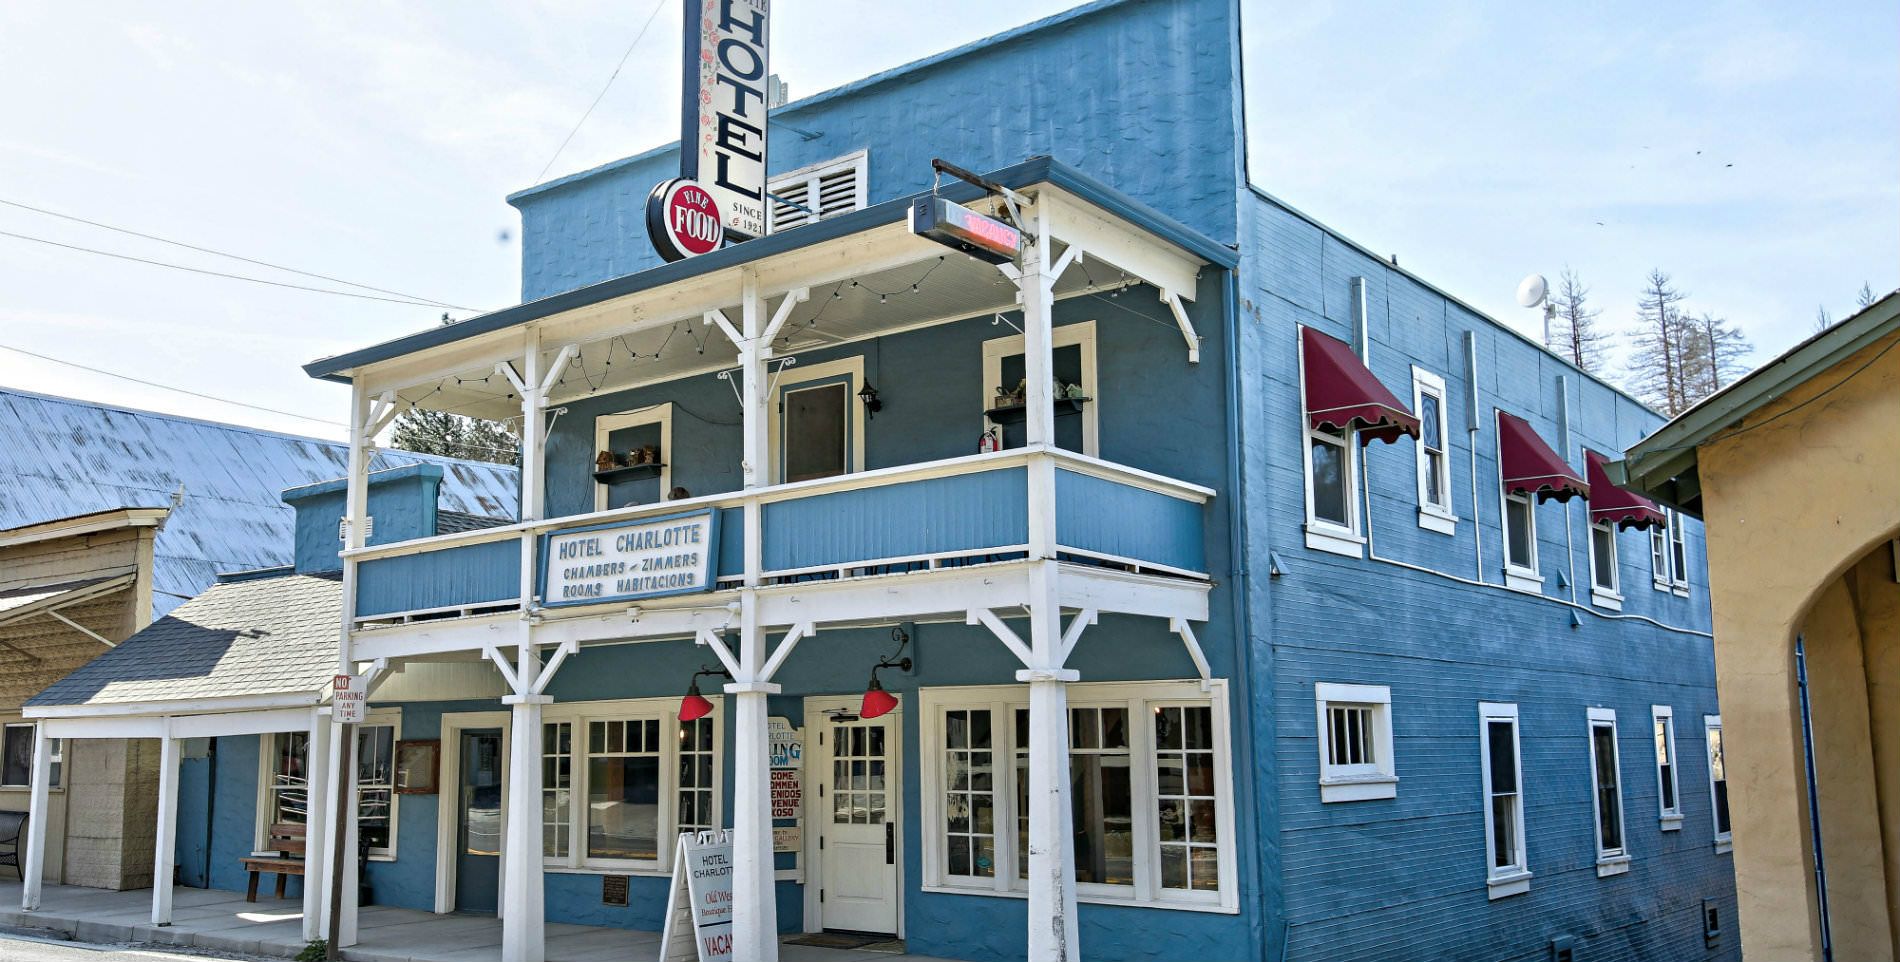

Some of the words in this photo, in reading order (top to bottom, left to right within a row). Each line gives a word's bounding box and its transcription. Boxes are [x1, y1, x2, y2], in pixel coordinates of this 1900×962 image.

[715, 0, 765, 201] HOTEL
[683, 190, 709, 209] FINE
[733, 202, 762, 220] SINCE
[674, 205, 719, 243] FOOD
[743, 219, 762, 234] 1921
[559, 538, 602, 560] HOTEL
[616, 523, 700, 553] CHARLOTTE
[563, 561, 625, 580] CHAMBERS
[642, 552, 698, 571] ZIMMERS
[563, 582, 602, 598] ROOMS
[616, 572, 695, 593] HABITACIONS
[335, 677, 348, 689] NO
[335, 691, 363, 701] PARKING
[769, 743, 801, 760] ING
[771, 772, 794, 781] COME
[702, 854, 728, 866] HOTEL
[704, 934, 732, 957] VACA
